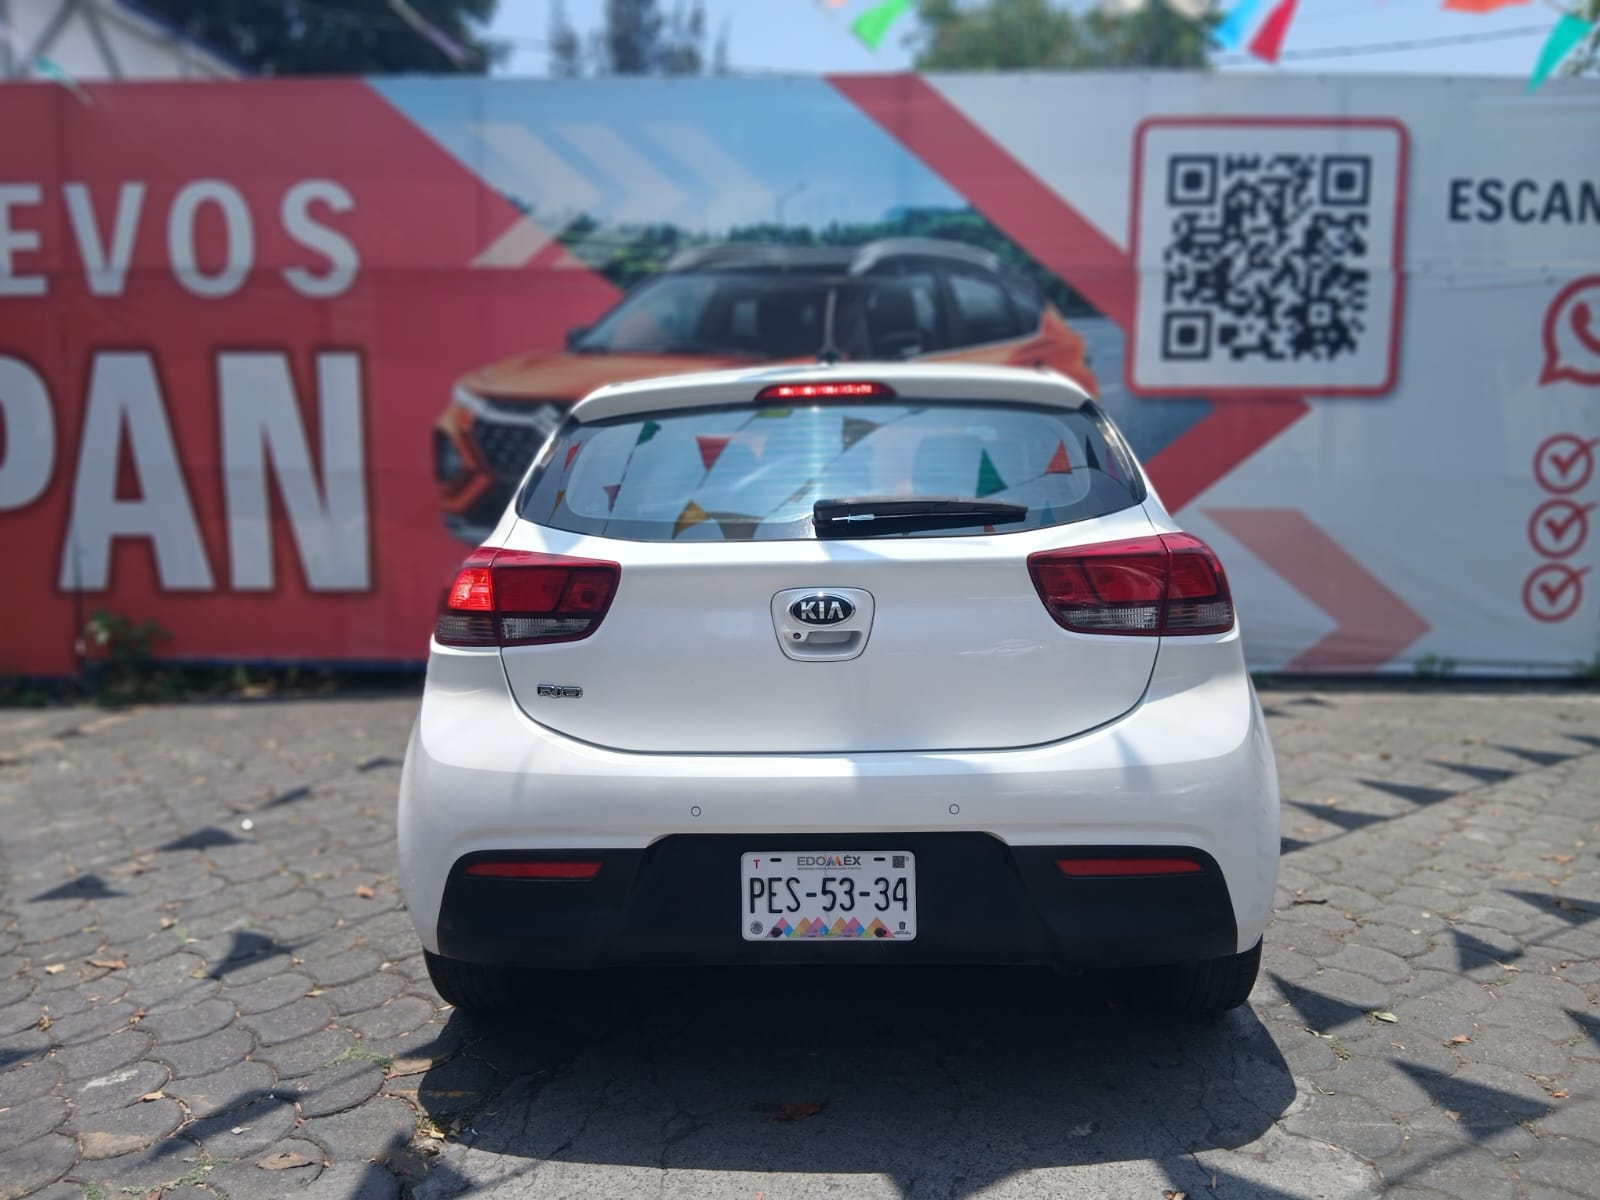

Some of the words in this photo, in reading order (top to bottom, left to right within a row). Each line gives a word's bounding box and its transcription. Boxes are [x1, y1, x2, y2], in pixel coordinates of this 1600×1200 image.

[1448, 177, 1600, 224] ESCAN
[0, 180, 359, 297] EVOS
[800, 601, 844, 619] KIA
[753, 859, 760, 869] T
[797, 855, 861, 866] EDOMÉX
[749, 877, 908, 914] PES-53-34
